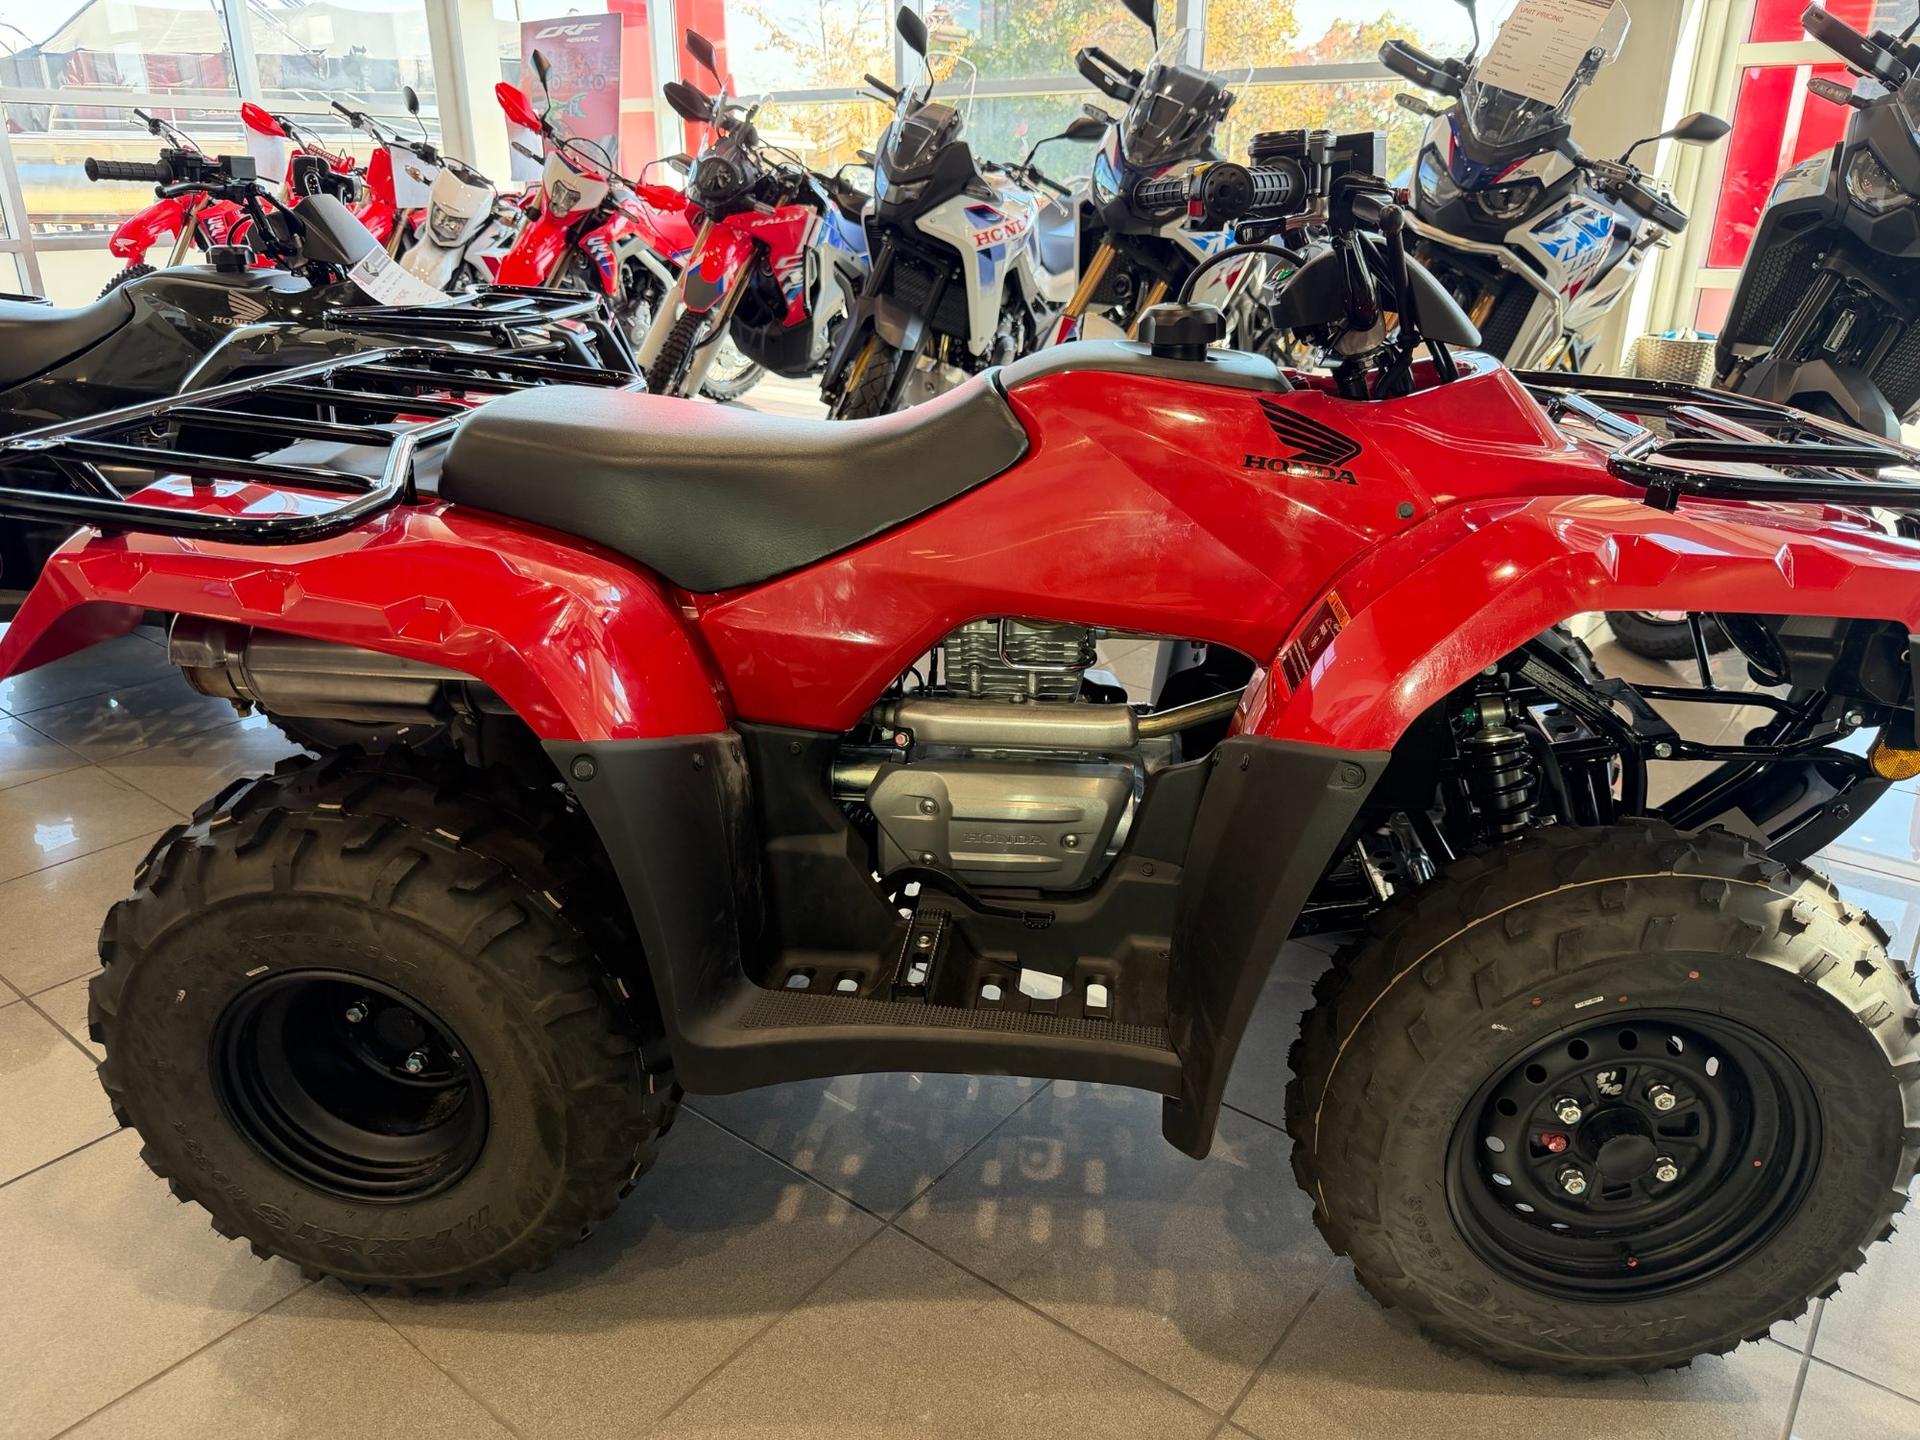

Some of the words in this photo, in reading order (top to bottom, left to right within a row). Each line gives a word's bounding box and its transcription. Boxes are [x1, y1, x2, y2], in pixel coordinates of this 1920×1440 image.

[535, 22, 601, 40] CRF
[751, 211, 803, 228] RALLY
[1242, 454, 1359, 486] HONDA
[962, 832, 1049, 847] HONDA
